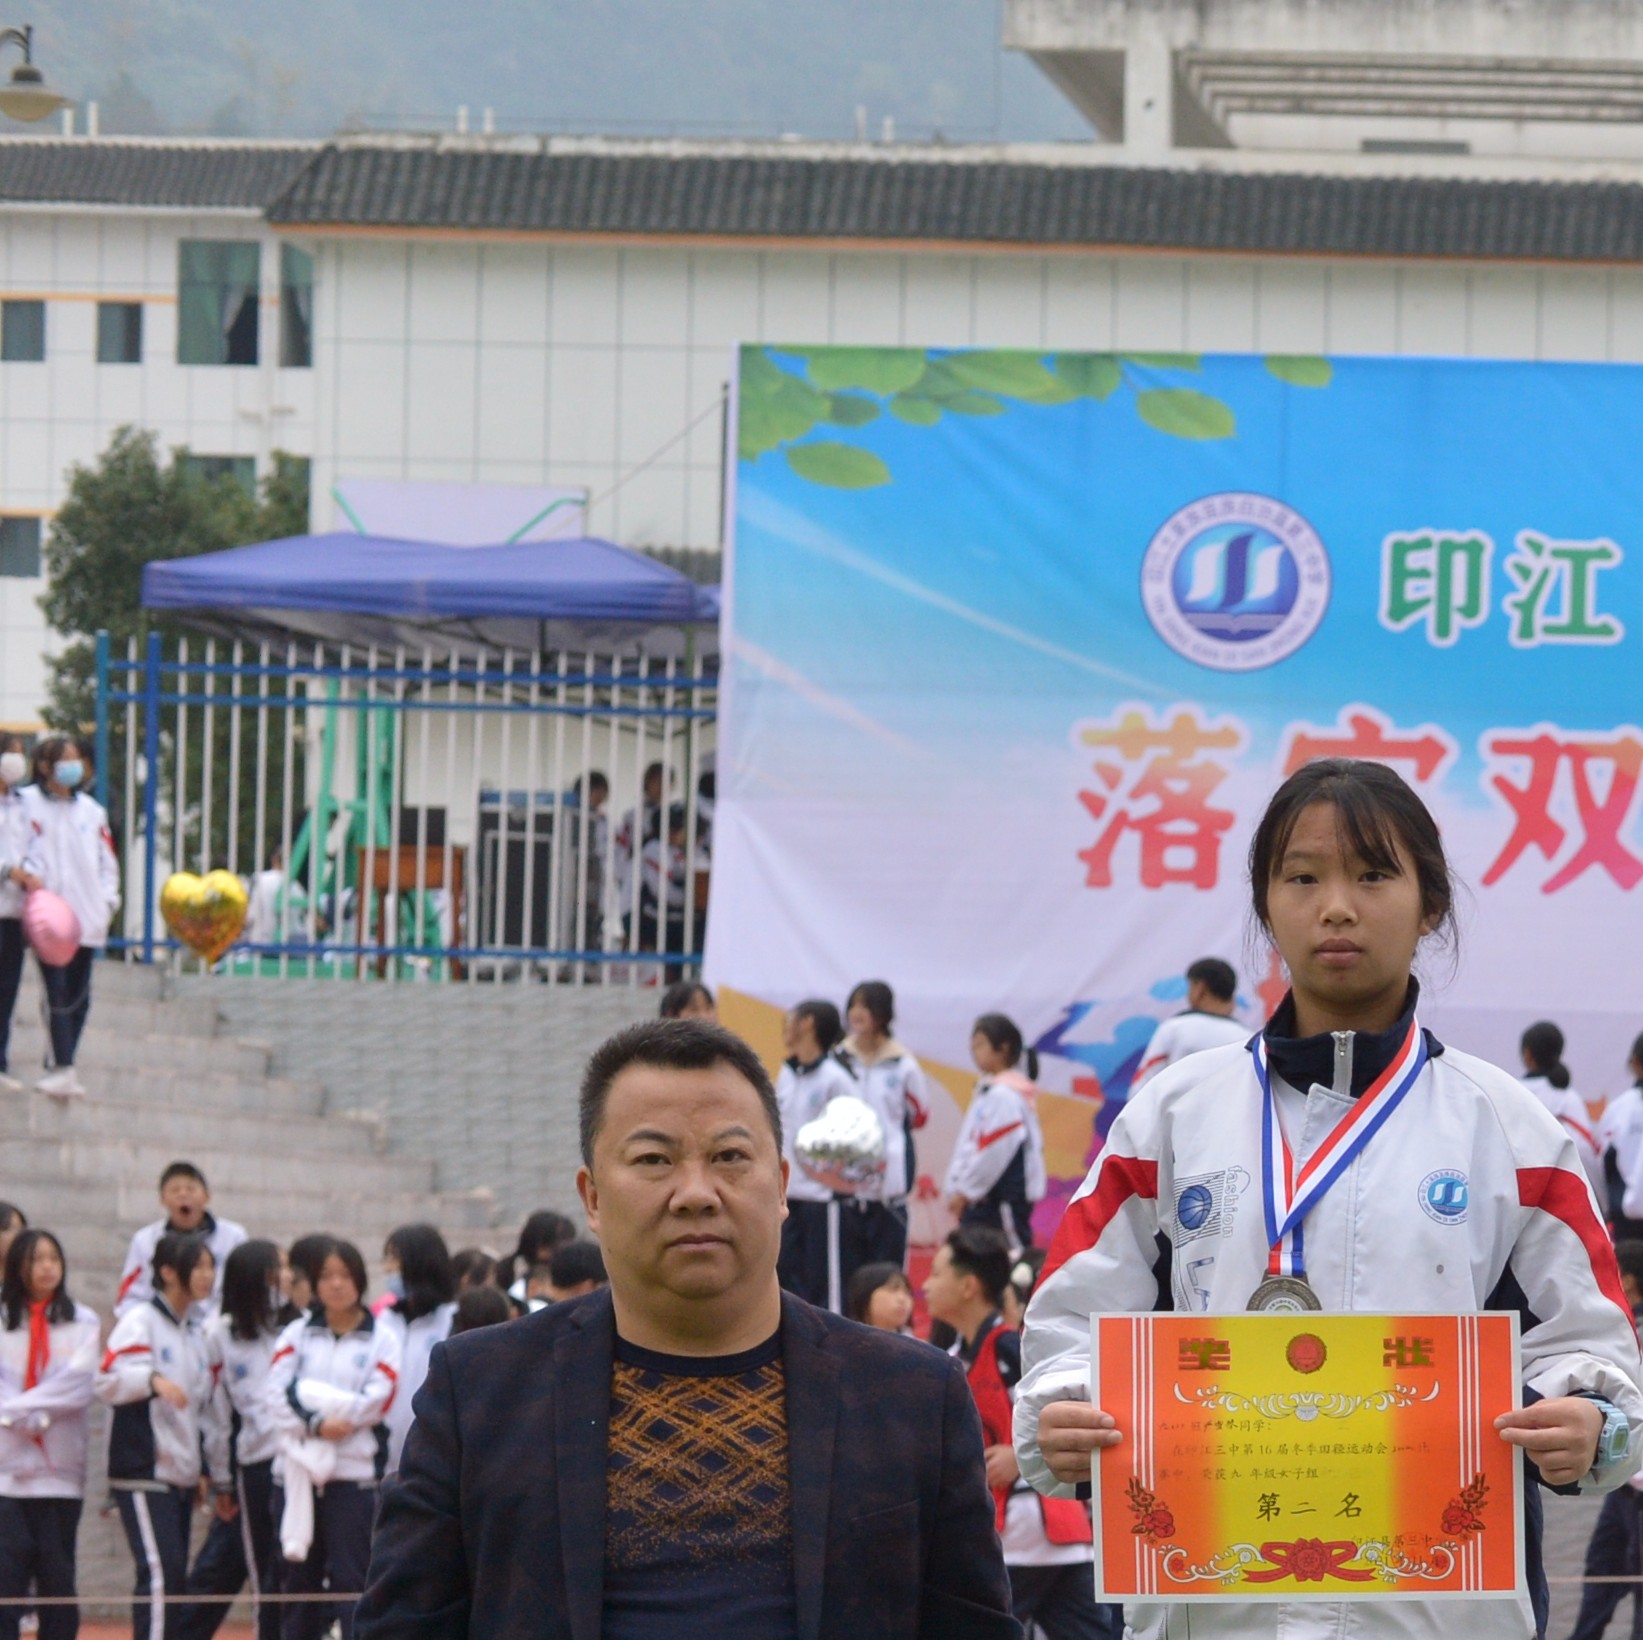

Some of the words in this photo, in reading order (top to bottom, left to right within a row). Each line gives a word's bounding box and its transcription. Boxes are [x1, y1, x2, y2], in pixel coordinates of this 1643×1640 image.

[1222, 1164, 1246, 1239] fashion
[1254, 1492, 1364, 1522] 第二名
